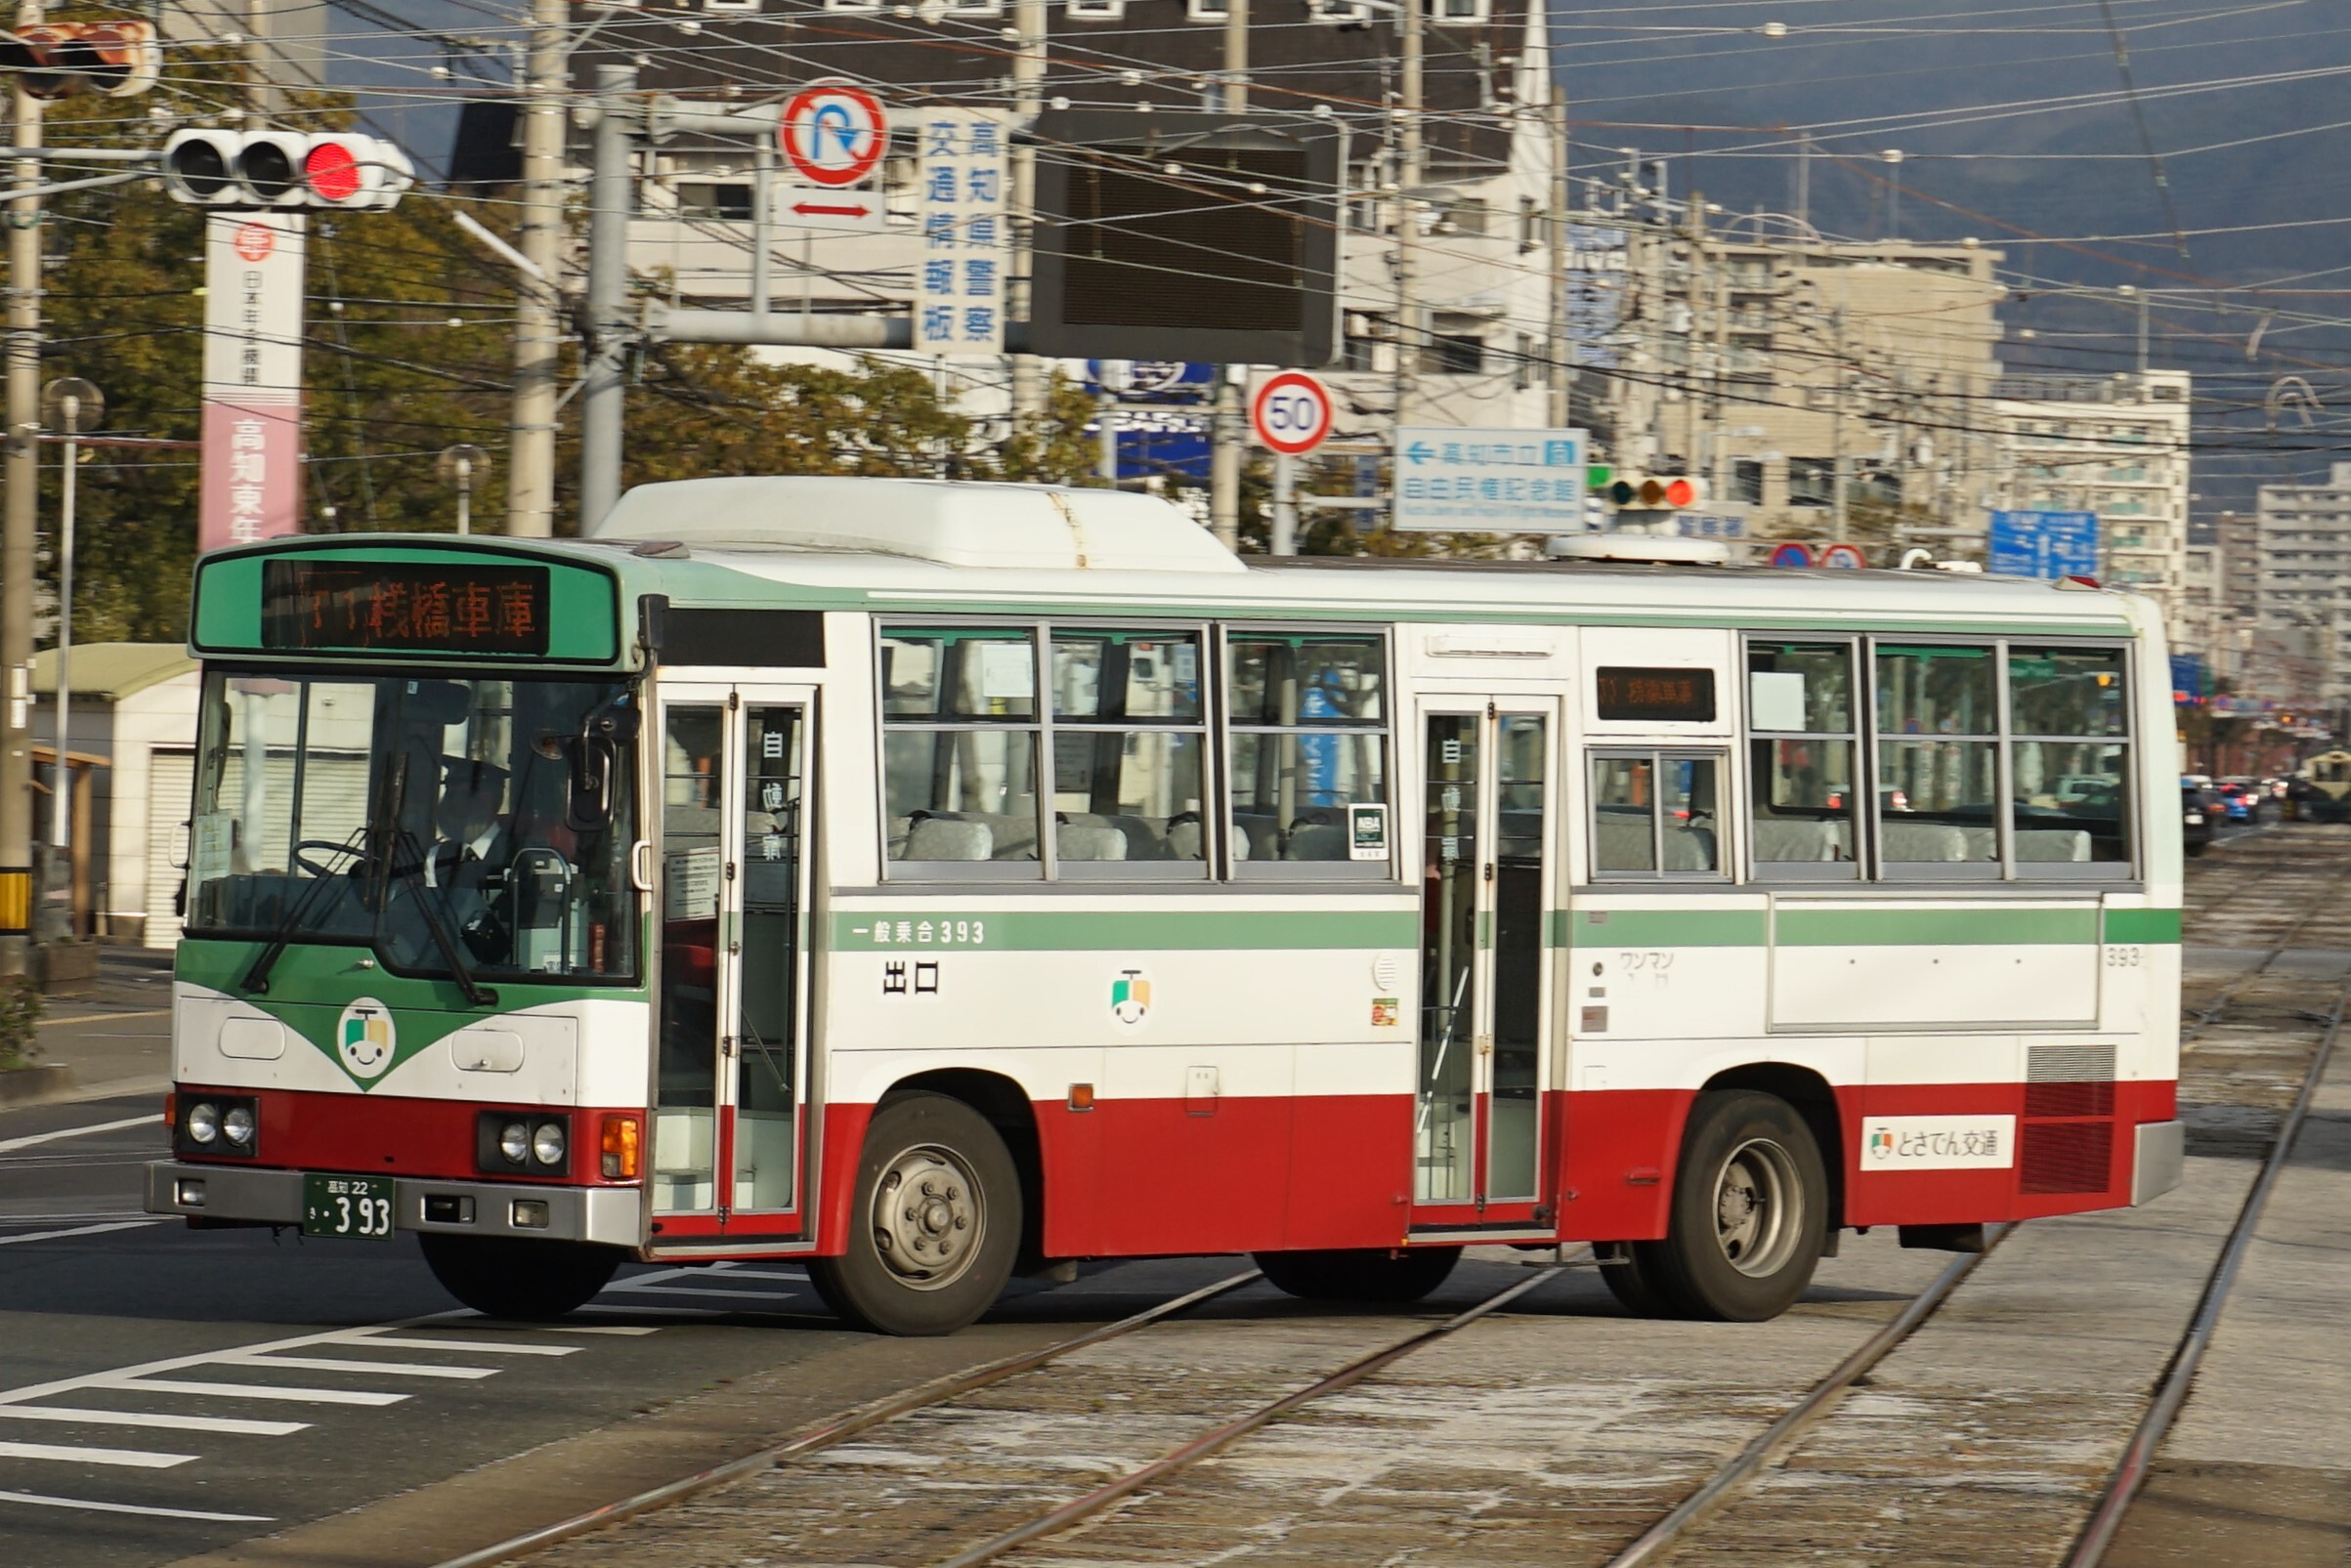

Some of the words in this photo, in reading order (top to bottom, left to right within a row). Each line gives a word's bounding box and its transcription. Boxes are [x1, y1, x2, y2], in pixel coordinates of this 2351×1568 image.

[922, 121, 959, 341] 交通情報板
[963, 121, 999, 341] 高知県警察
[1269, 396, 1315, 430] 50
[1620, 952, 1674, 970] ワンマン
[2106, 947, 2140, 967] 393
[883, 960, 939, 995] 出口
[1898, 1129, 1998, 1157] とさでん交通
[352, 1181, 368, 1195] 22
